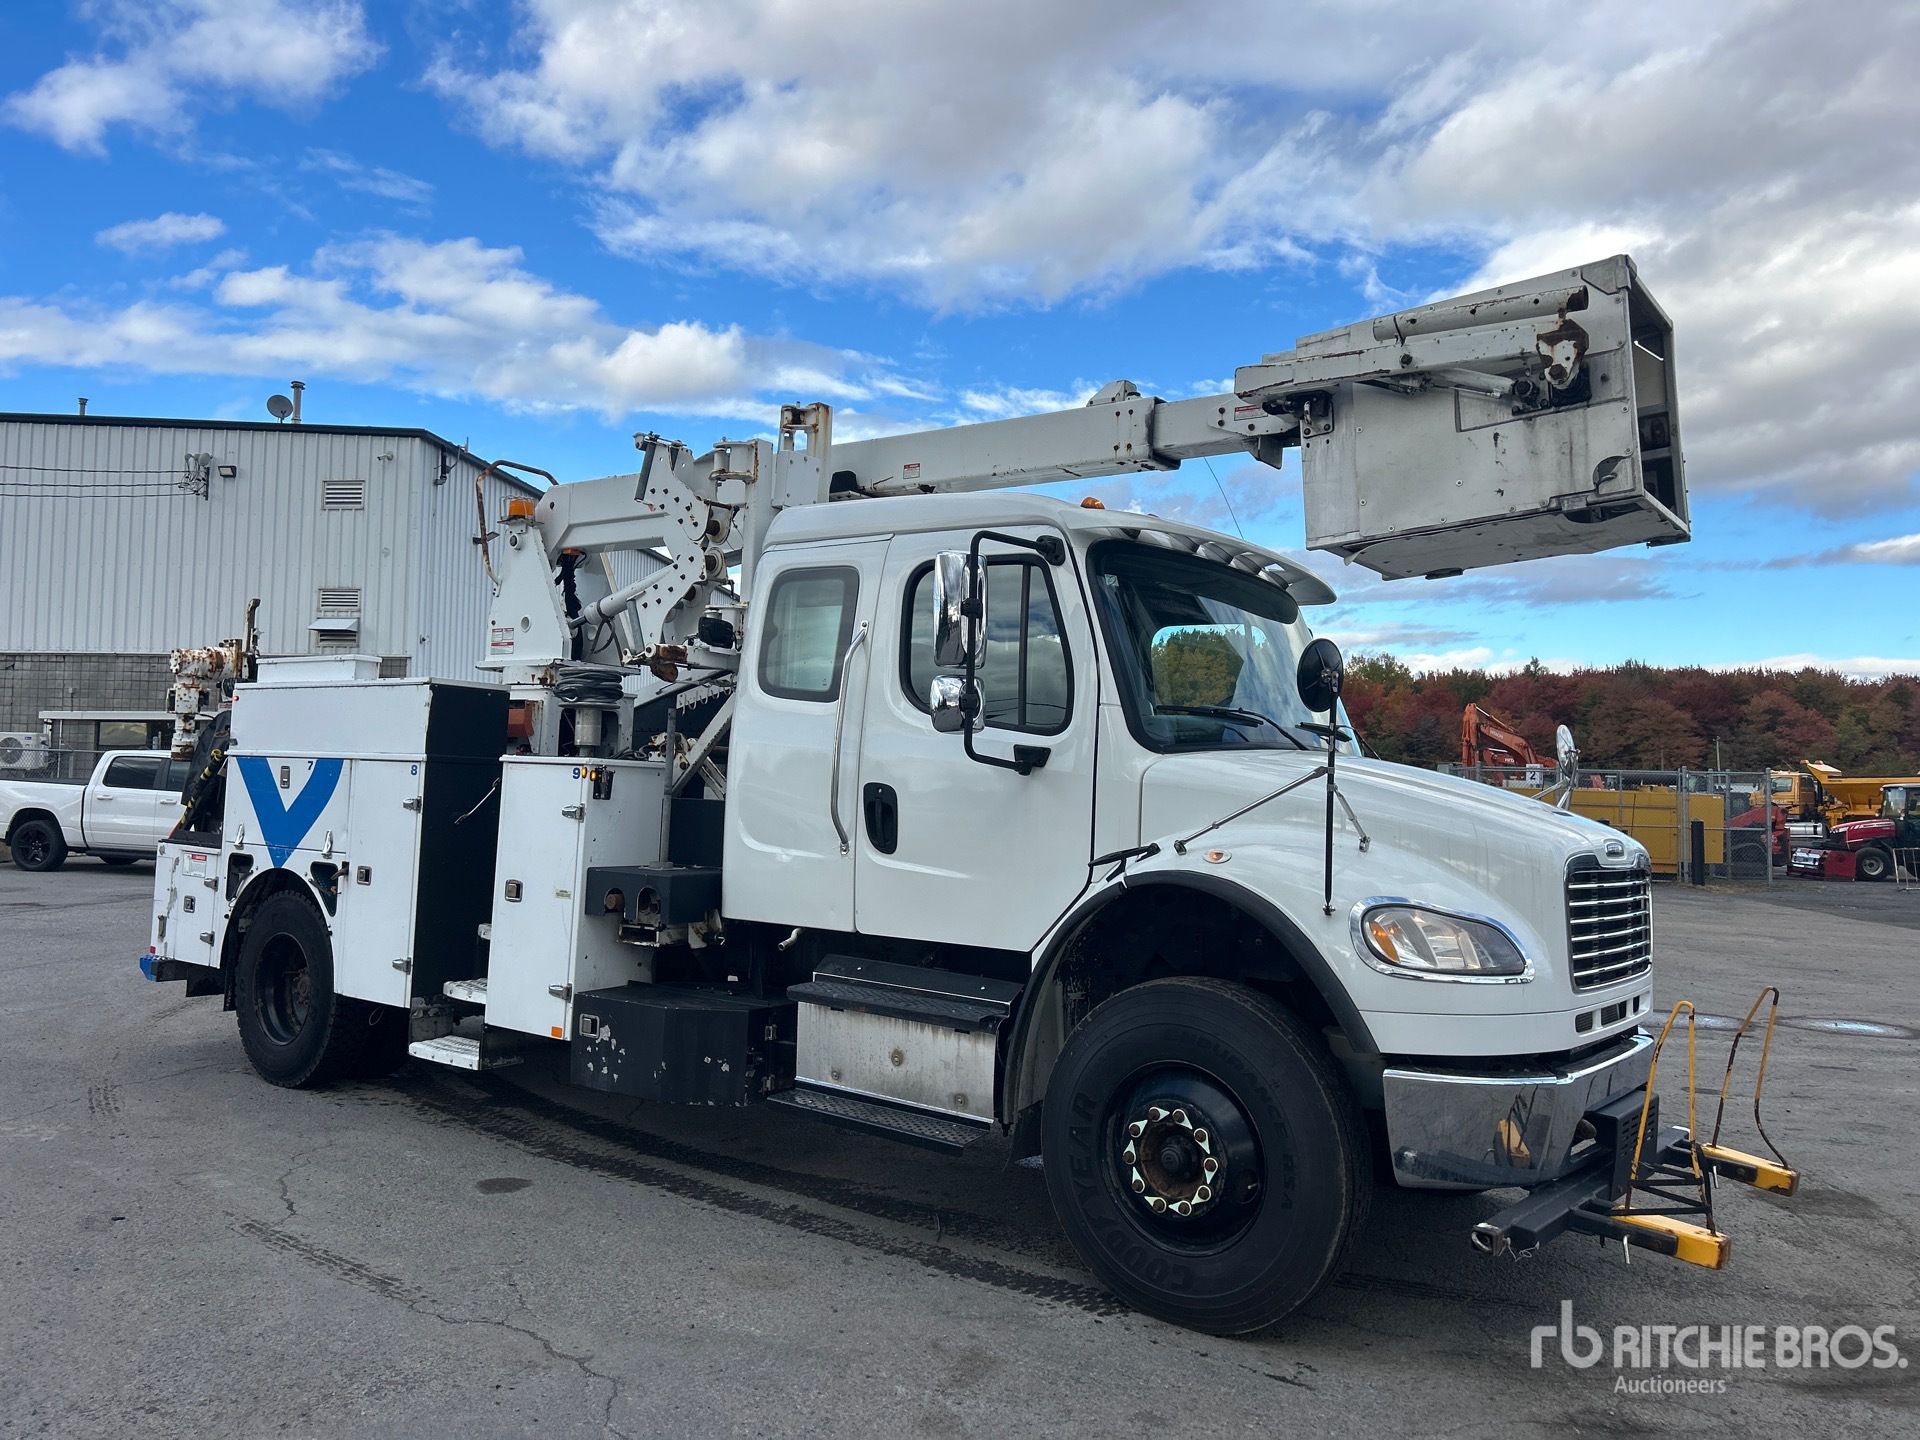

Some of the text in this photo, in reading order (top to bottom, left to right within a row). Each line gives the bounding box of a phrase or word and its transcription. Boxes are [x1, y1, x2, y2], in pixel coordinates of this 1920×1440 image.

[307, 760, 314, 771] 7
[410, 764, 418, 776] 8
[572, 767, 581, 780] 9
[1529, 769, 1537, 780] 2
[1163, 1028, 1297, 1211] ENDURANCE RSA
